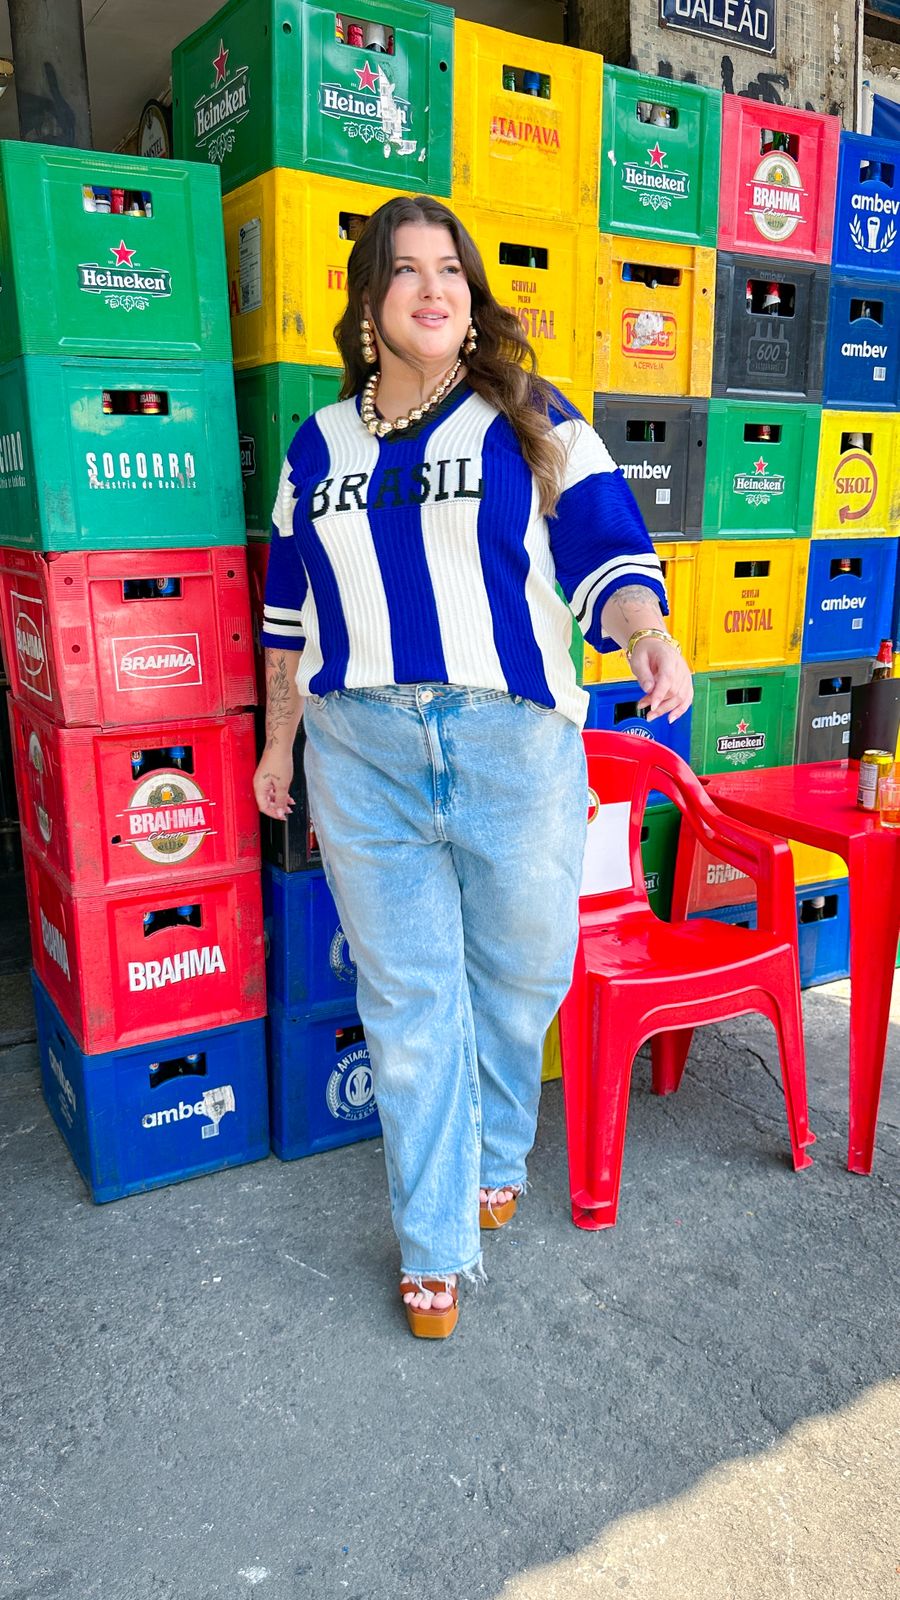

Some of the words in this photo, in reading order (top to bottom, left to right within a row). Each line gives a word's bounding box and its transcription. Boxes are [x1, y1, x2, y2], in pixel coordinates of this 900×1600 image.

[196, 84, 247, 137] Heineken
[324, 89, 407, 124] Heinen
[493, 116, 560, 148] ITAIPAVA
[625, 168, 685, 192] Heineken
[753, 186, 800, 213] BRAHMA
[851, 193, 900, 215] ambev
[82, 269, 166, 291] Heineken
[512, 280, 537, 293] CERVEJA
[757, 343, 780, 361] 600
[841, 340, 887, 359] ambev
[86, 452, 196, 479] SOCORRO
[619, 460, 671, 479] ambev
[309, 458, 484, 520] BRASIL
[736, 478, 781, 490] Heineken
[836, 477, 872, 494] SKOL
[821, 595, 867, 611] ambev
[724, 608, 773, 633] CRYSTAL
[120, 653, 196, 672] BRAHMA
[720, 737, 762, 750] Heineken
[129, 806, 206, 835] BRAHMA
[128, 945, 226, 992] BRAHMA
[337, 1049, 370, 1073] ANTARC
[142, 1101, 206, 1129] ambe
